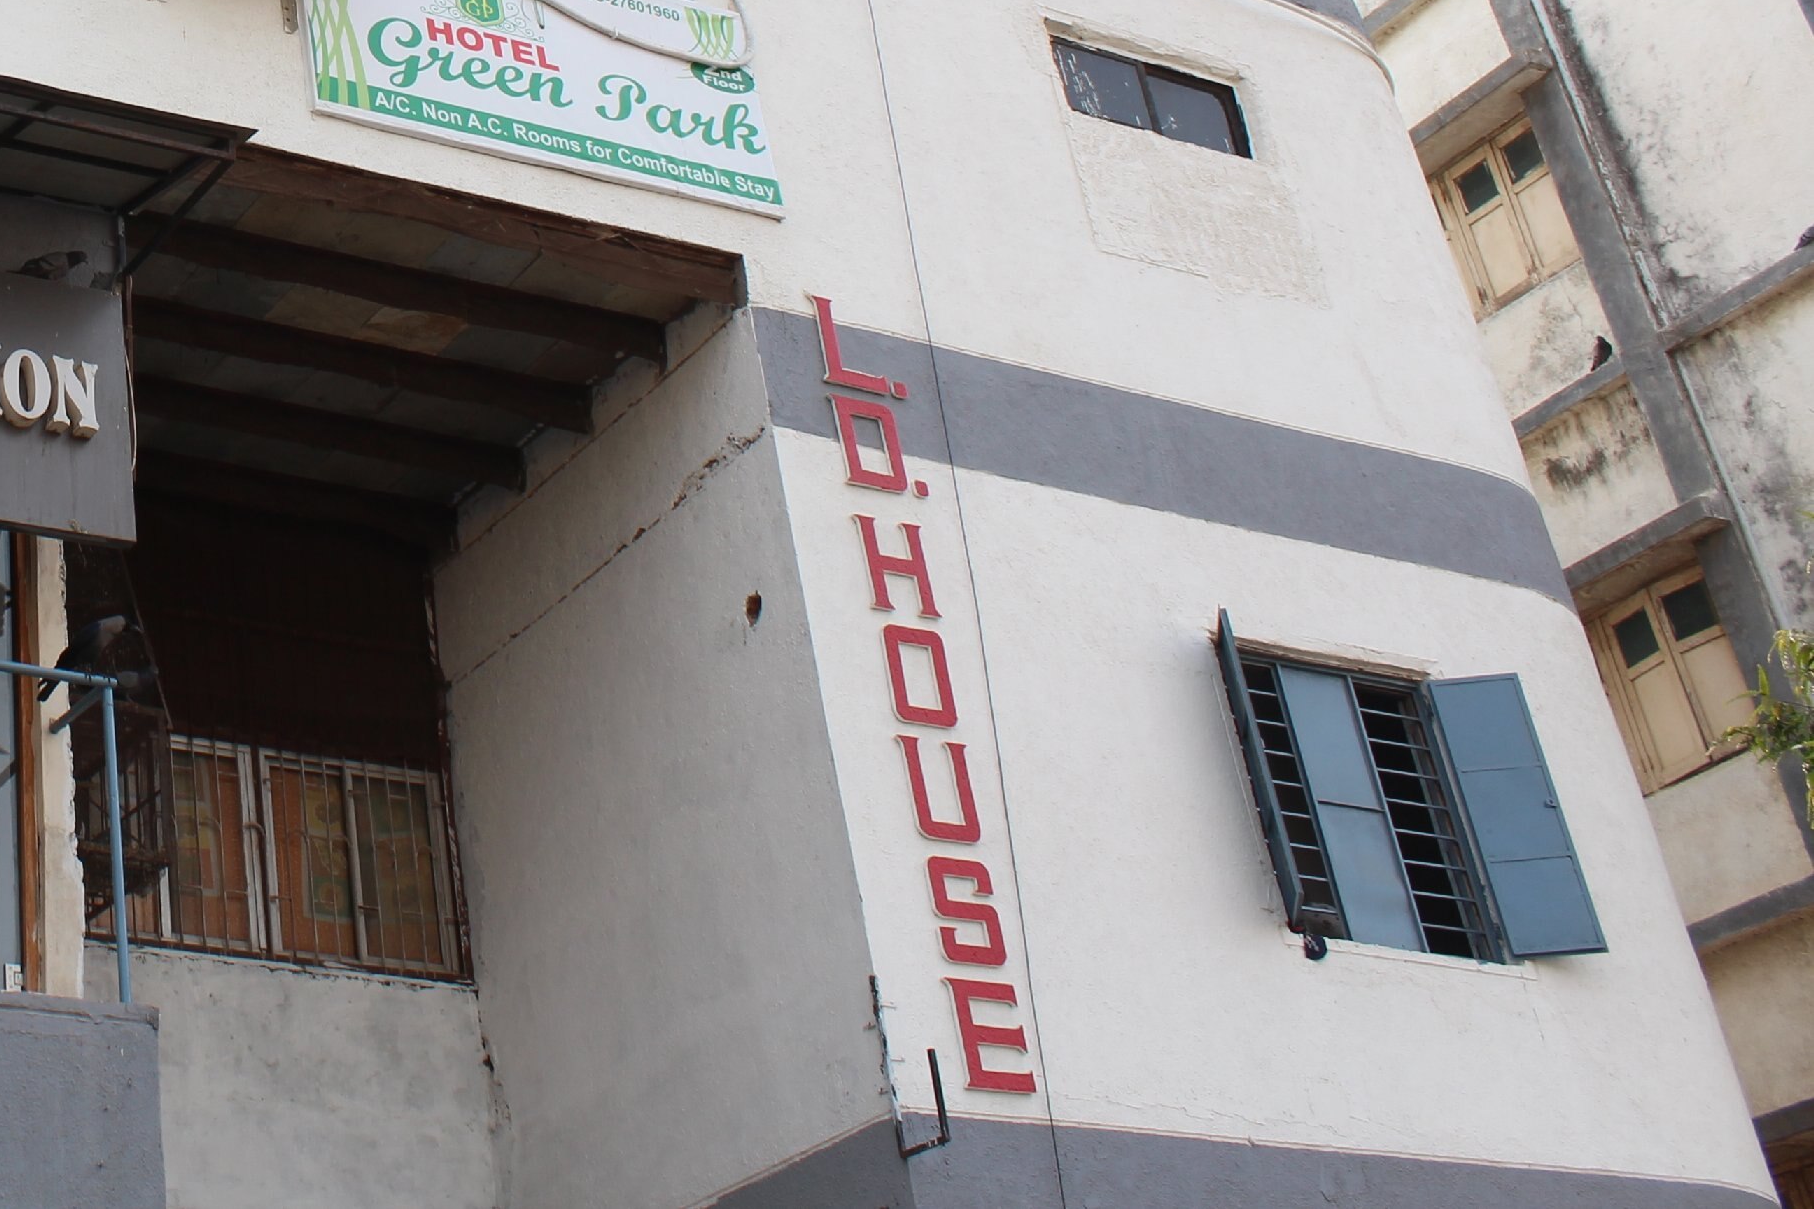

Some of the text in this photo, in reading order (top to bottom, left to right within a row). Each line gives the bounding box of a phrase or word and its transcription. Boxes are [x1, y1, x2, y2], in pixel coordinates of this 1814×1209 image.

[367, 17, 766, 155] Green Park
[426, 18, 560, 72] HOTEL
[704, 74, 746, 92] Floor
[422, 101, 462, 126] Non
[468, 113, 508, 136] A.C.
[512, 122, 582, 153] Rooms
[586, 140, 613, 161] for
[617, 147, 732, 189] Comfortable
[735, 175, 775, 201] Stay
[851, 513, 1036, 1096] HOUSE
